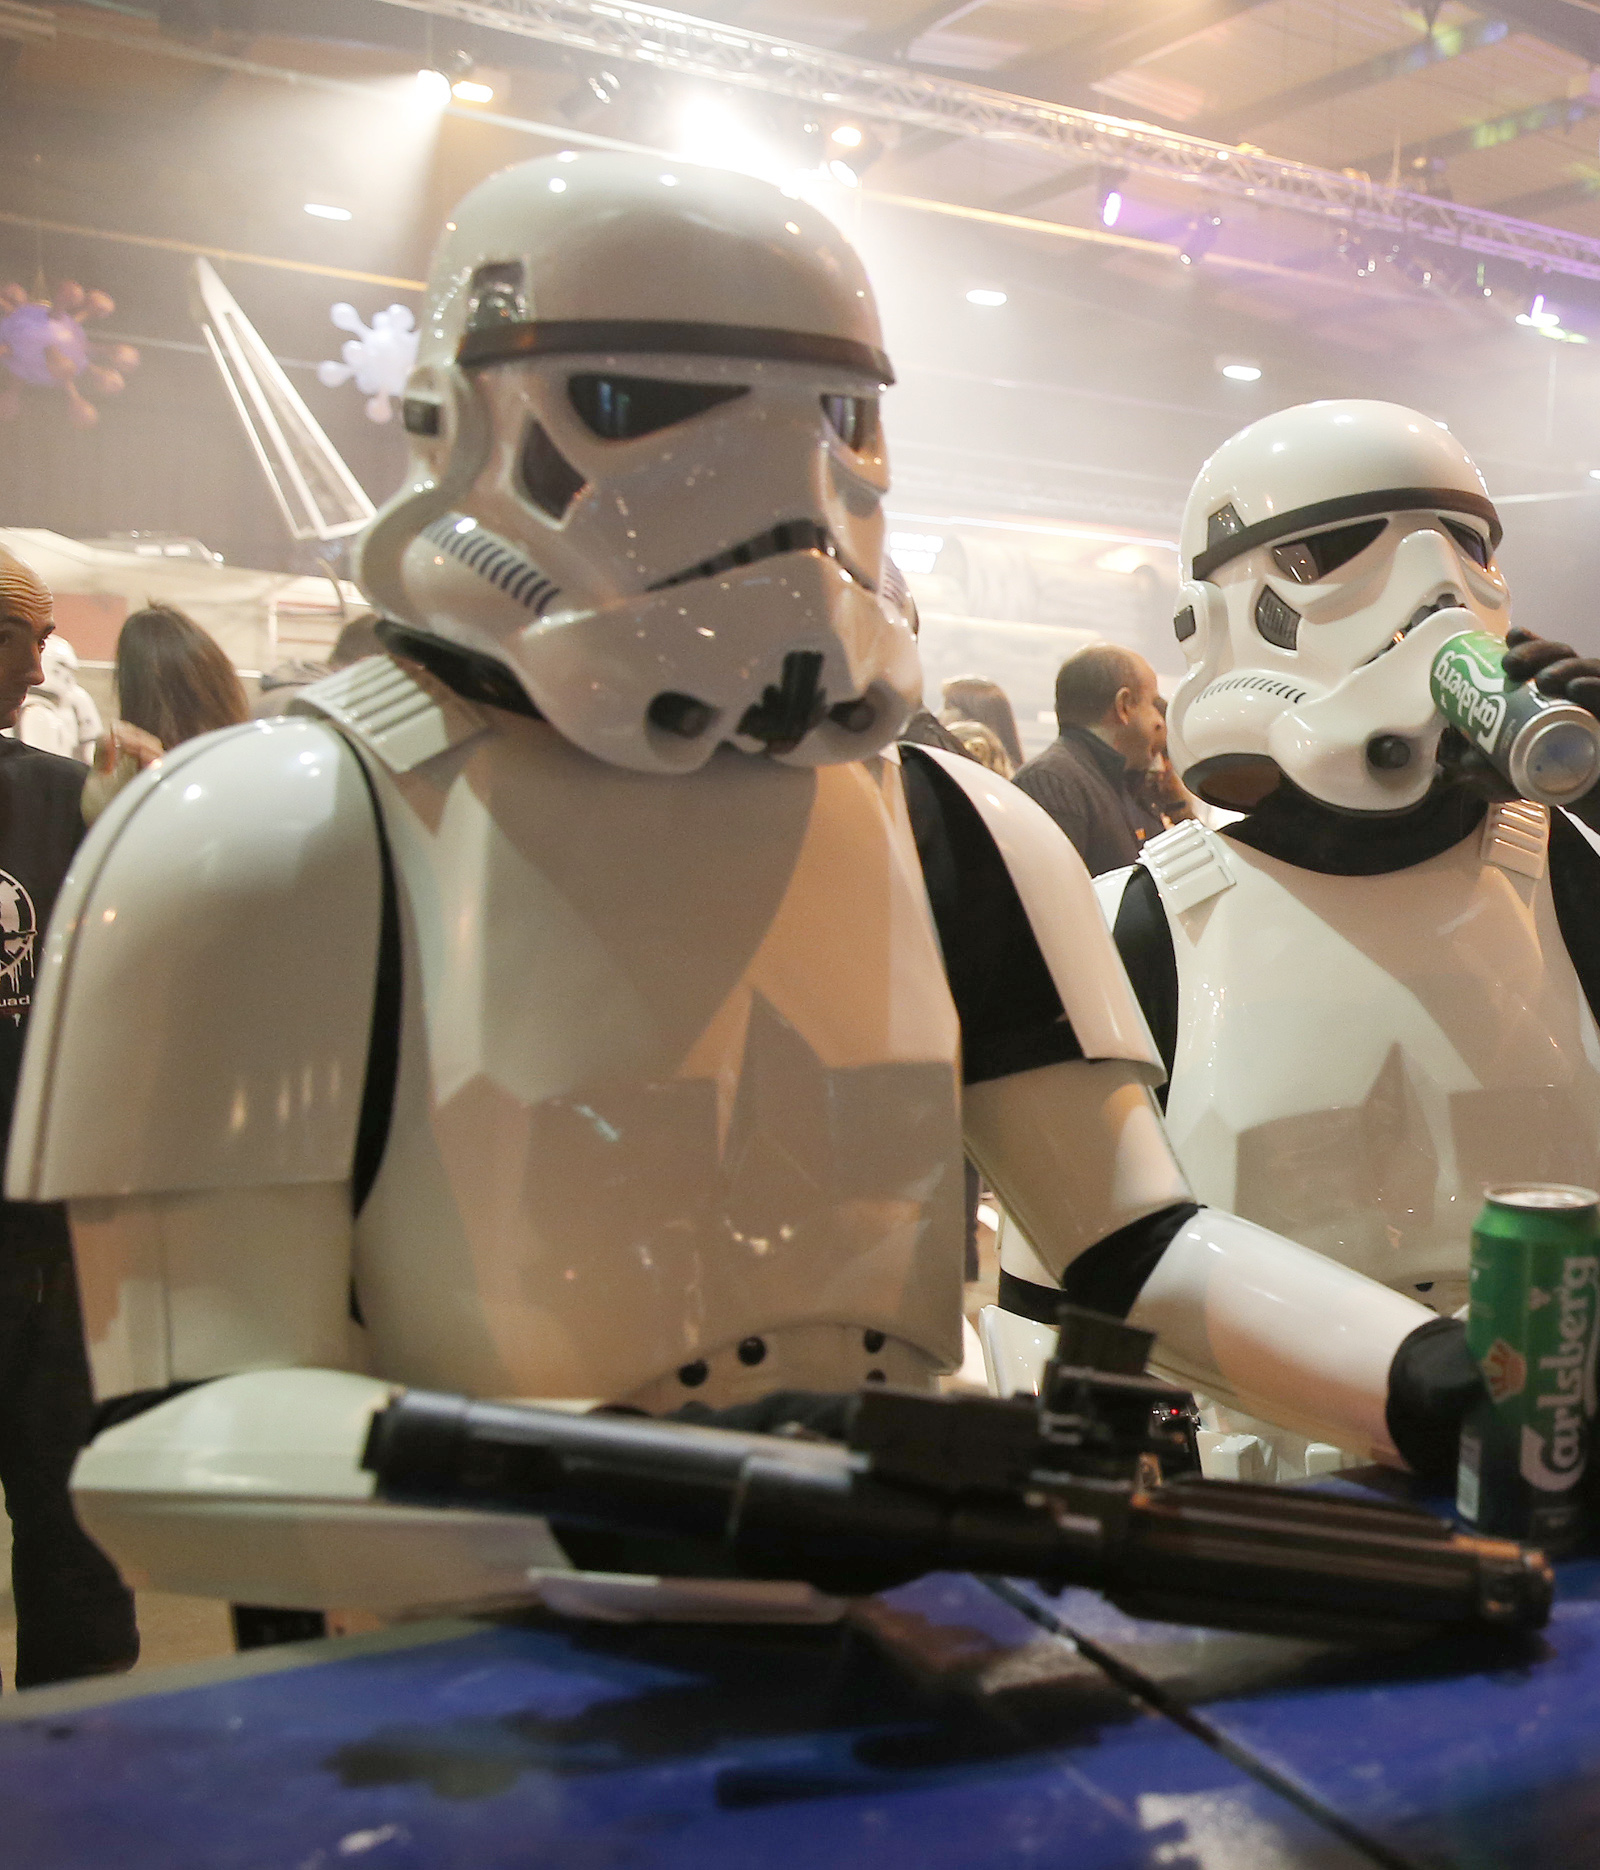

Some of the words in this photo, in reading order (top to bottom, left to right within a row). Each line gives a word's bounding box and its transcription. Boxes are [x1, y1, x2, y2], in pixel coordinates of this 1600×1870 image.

[1434, 650, 1507, 754] Carlsberg
[0, 995, 30, 1006] uad
[1520, 1257, 1600, 1492] Carlsberg
